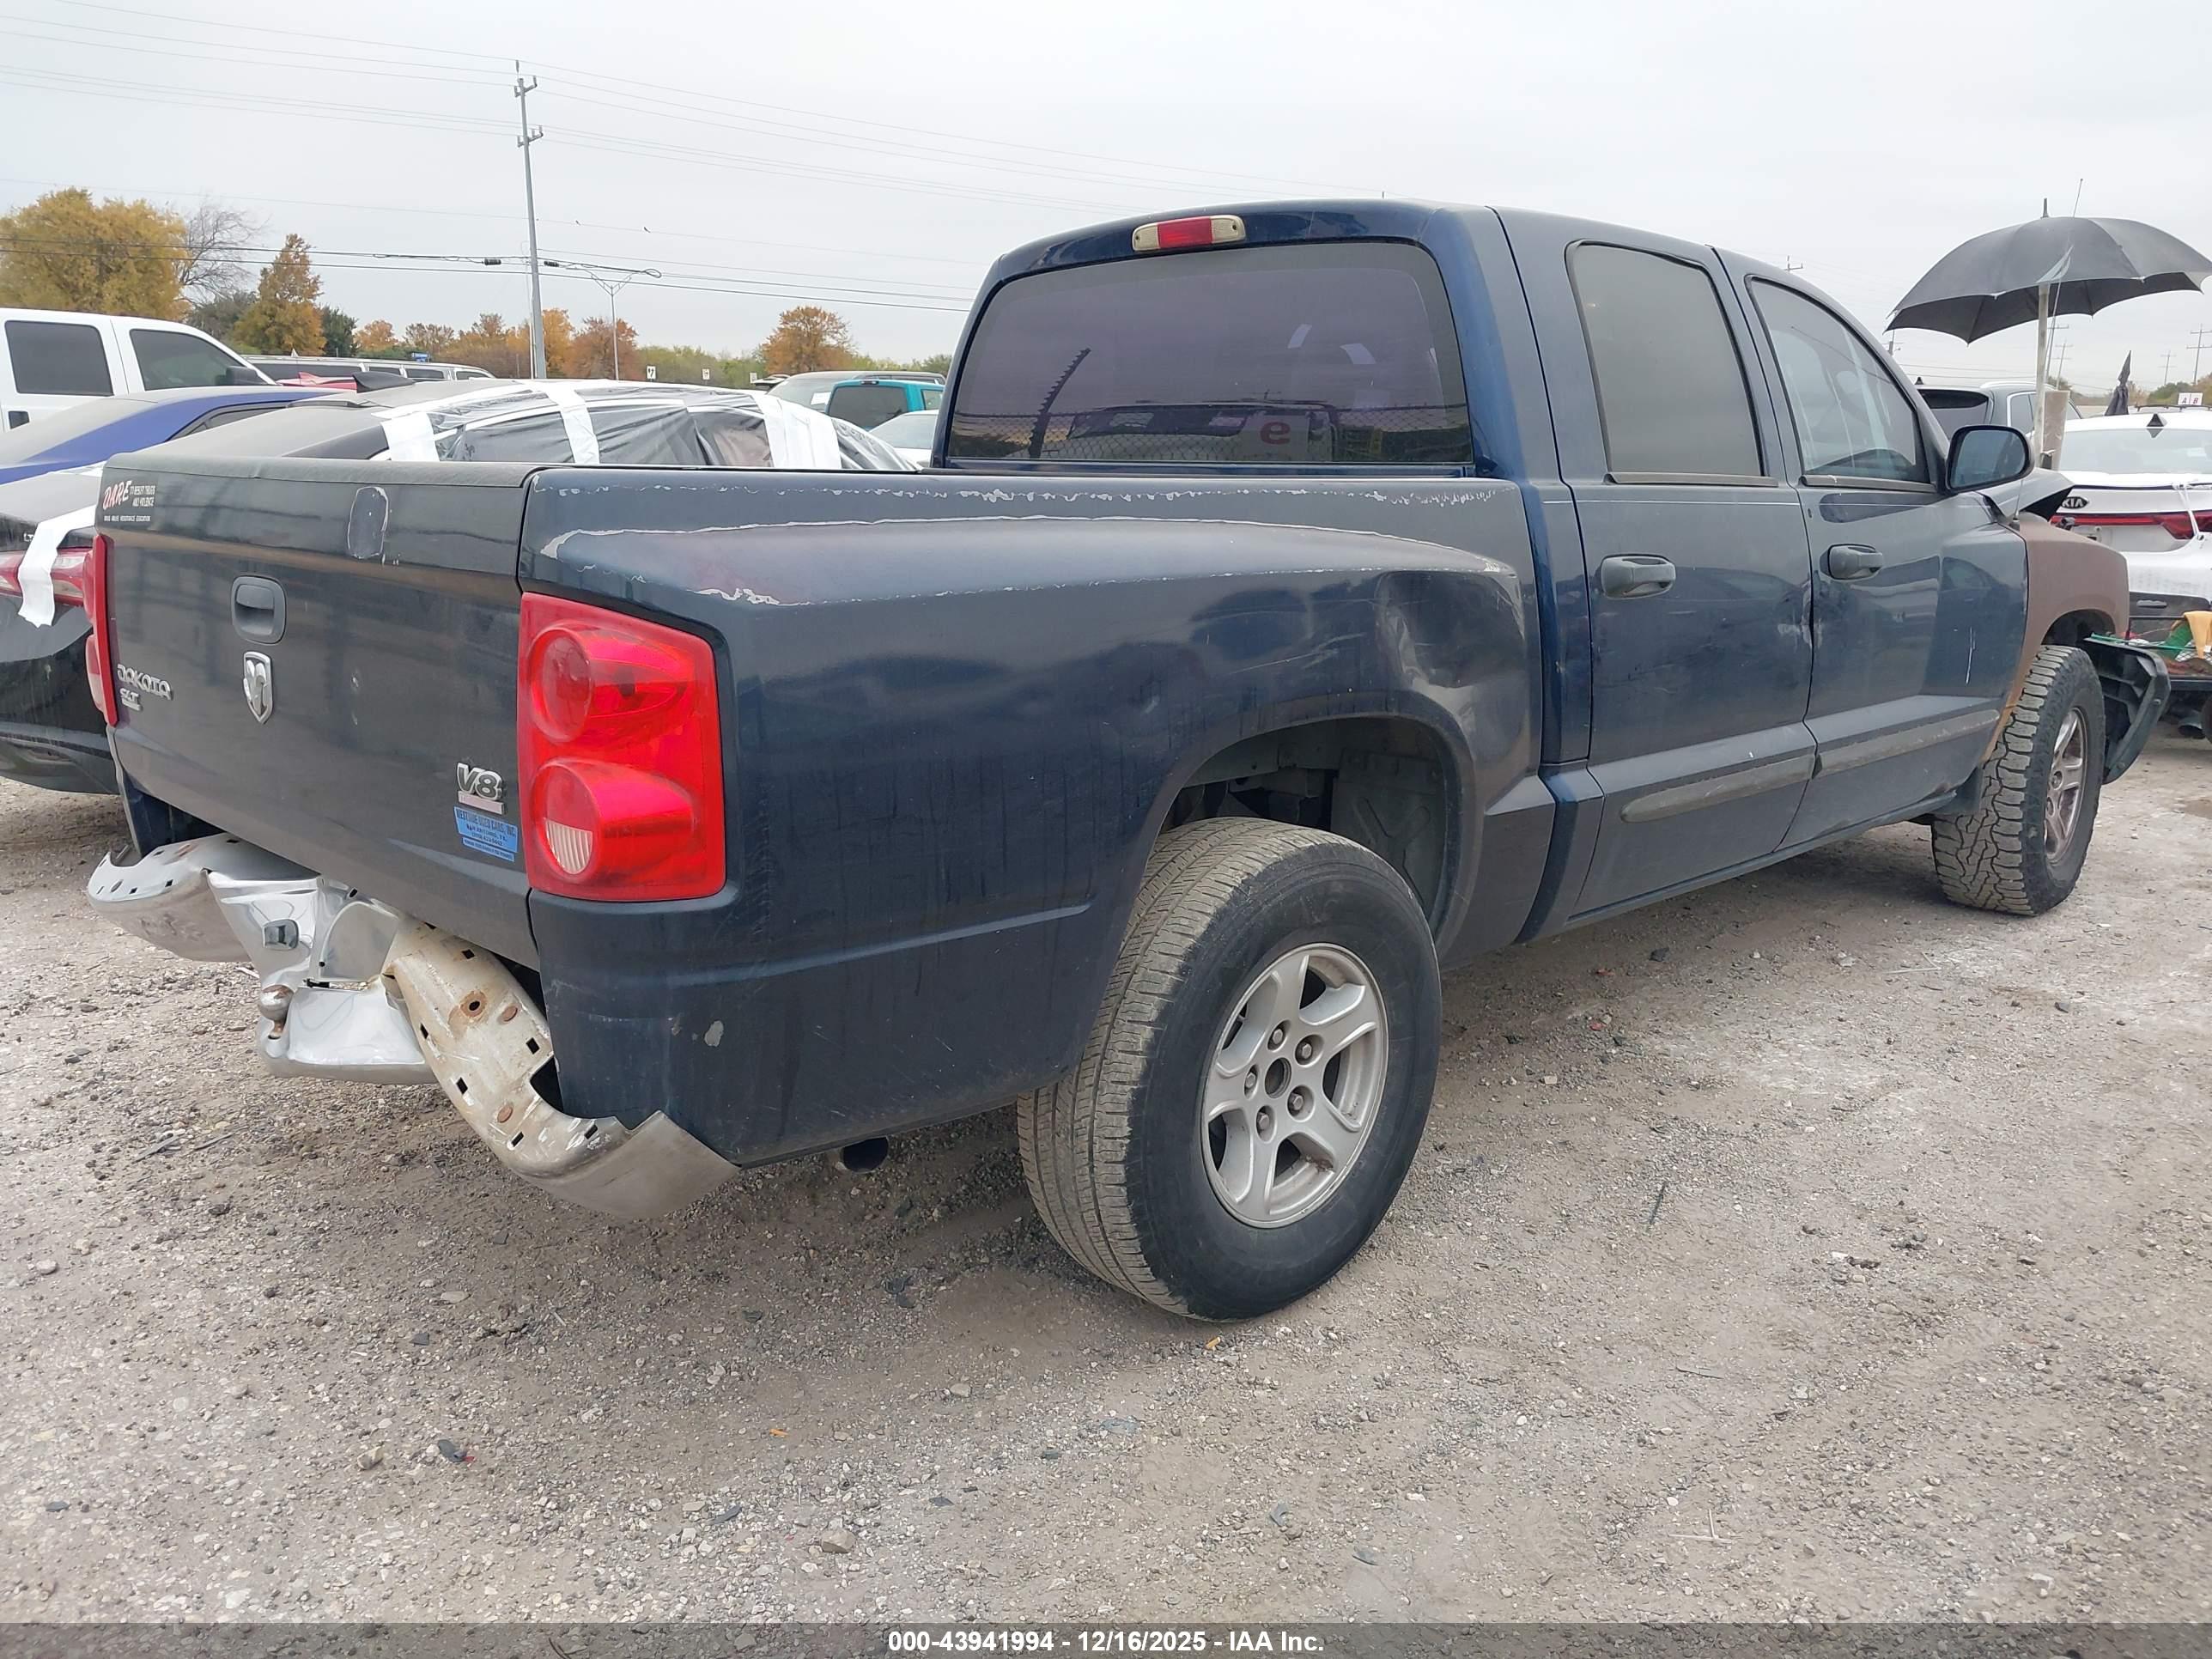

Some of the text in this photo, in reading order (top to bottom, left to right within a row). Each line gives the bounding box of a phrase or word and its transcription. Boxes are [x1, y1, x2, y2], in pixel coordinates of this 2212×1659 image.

[2062, 498, 2083, 507] KIA
[117, 663, 171, 701] DAKOTA
[457, 763, 503, 800] V8
